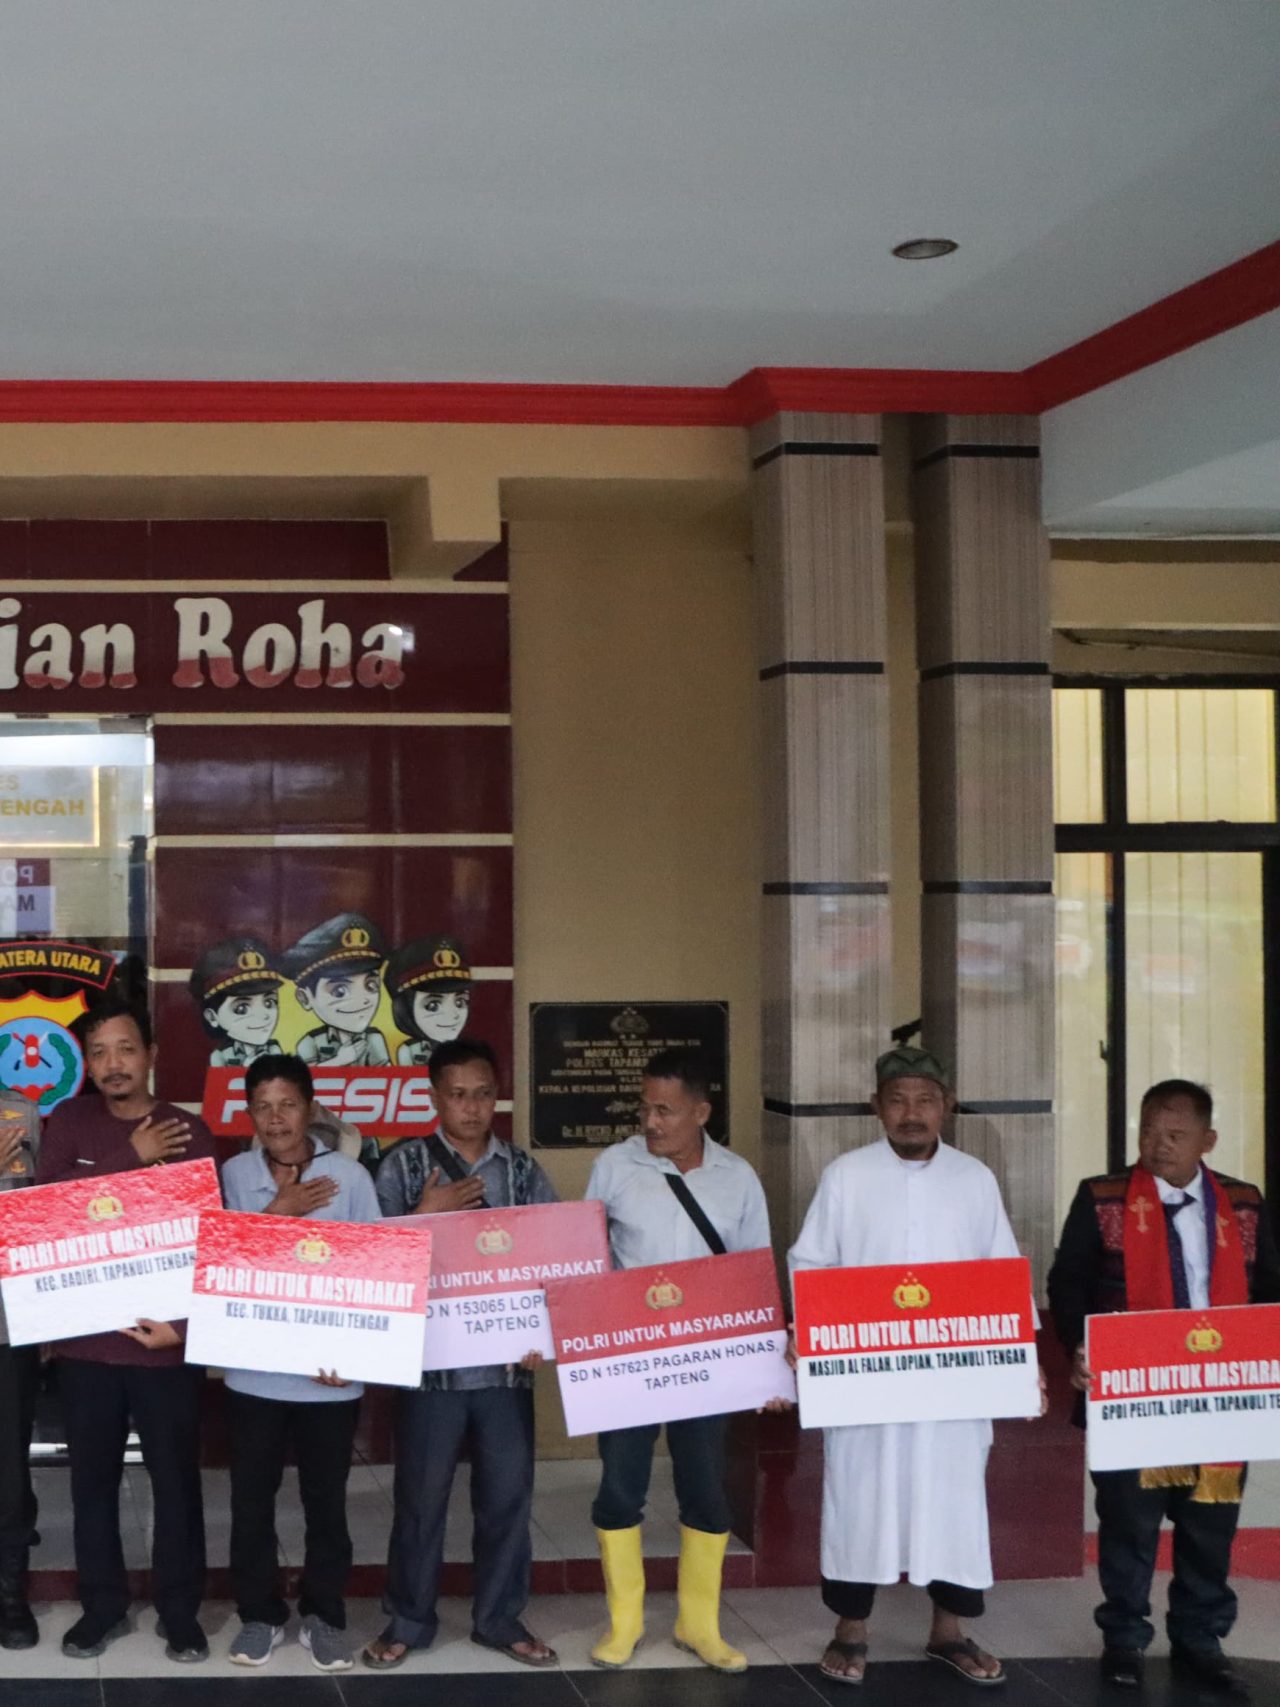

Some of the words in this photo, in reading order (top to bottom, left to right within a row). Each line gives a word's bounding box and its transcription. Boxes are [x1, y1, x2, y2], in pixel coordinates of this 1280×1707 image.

[173, 598, 406, 690] Roha
[50, 951, 101, 975] UTARA
[9, 1241, 55, 1271] POLRI
[56, 1232, 109, 1264] UNTUK
[35, 1277, 59, 1292] KEC.
[102, 1259, 153, 1281] TAPANULI
[206, 1265, 251, 1292] POLRI
[255, 1269, 309, 1298] UNTUK
[310, 1275, 416, 1308] MASYARAKAT
[441, 1270, 494, 1289] UNTUK
[497, 1259, 604, 1282] MASYARAKAT
[226, 1301, 249, 1318] KEC.
[252, 1303, 290, 1323] TUKKA,
[293, 1307, 344, 1327] TAPANULI
[347, 1312, 389, 1331] TENGAH
[439, 1305, 450, 1317] N
[456, 1298, 505, 1316] 153065
[464, 1315, 540, 1334] TAPTENG
[562, 1334, 610, 1354] POLRI
[612, 1324, 667, 1346] UNTUK
[669, 1307, 775, 1336] MASYARAKAT
[809, 1324, 856, 1351] POLRI
[858, 1320, 913, 1348] UNTUK
[914, 1314, 1020, 1344] MASYARAKAT
[570, 1369, 588, 1383] SD
[592, 1367, 602, 1379] N
[606, 1360, 649, 1376] 157623
[653, 1350, 722, 1369] PAGARAN
[809, 1359, 845, 1377] MASJID
[848, 1359, 858, 1374] AL
[936, 1350, 984, 1368] TAPANULI
[986, 1348, 1027, 1365] TENGAH
[1100, 1367, 1146, 1395] POLRI
[1148, 1363, 1202, 1391] UNTUK
[1204, 1360, 1280, 1387] MASYARA
[645, 1369, 710, 1390] TAPTENG
[1214, 1394, 1266, 1412] TAPANULI
